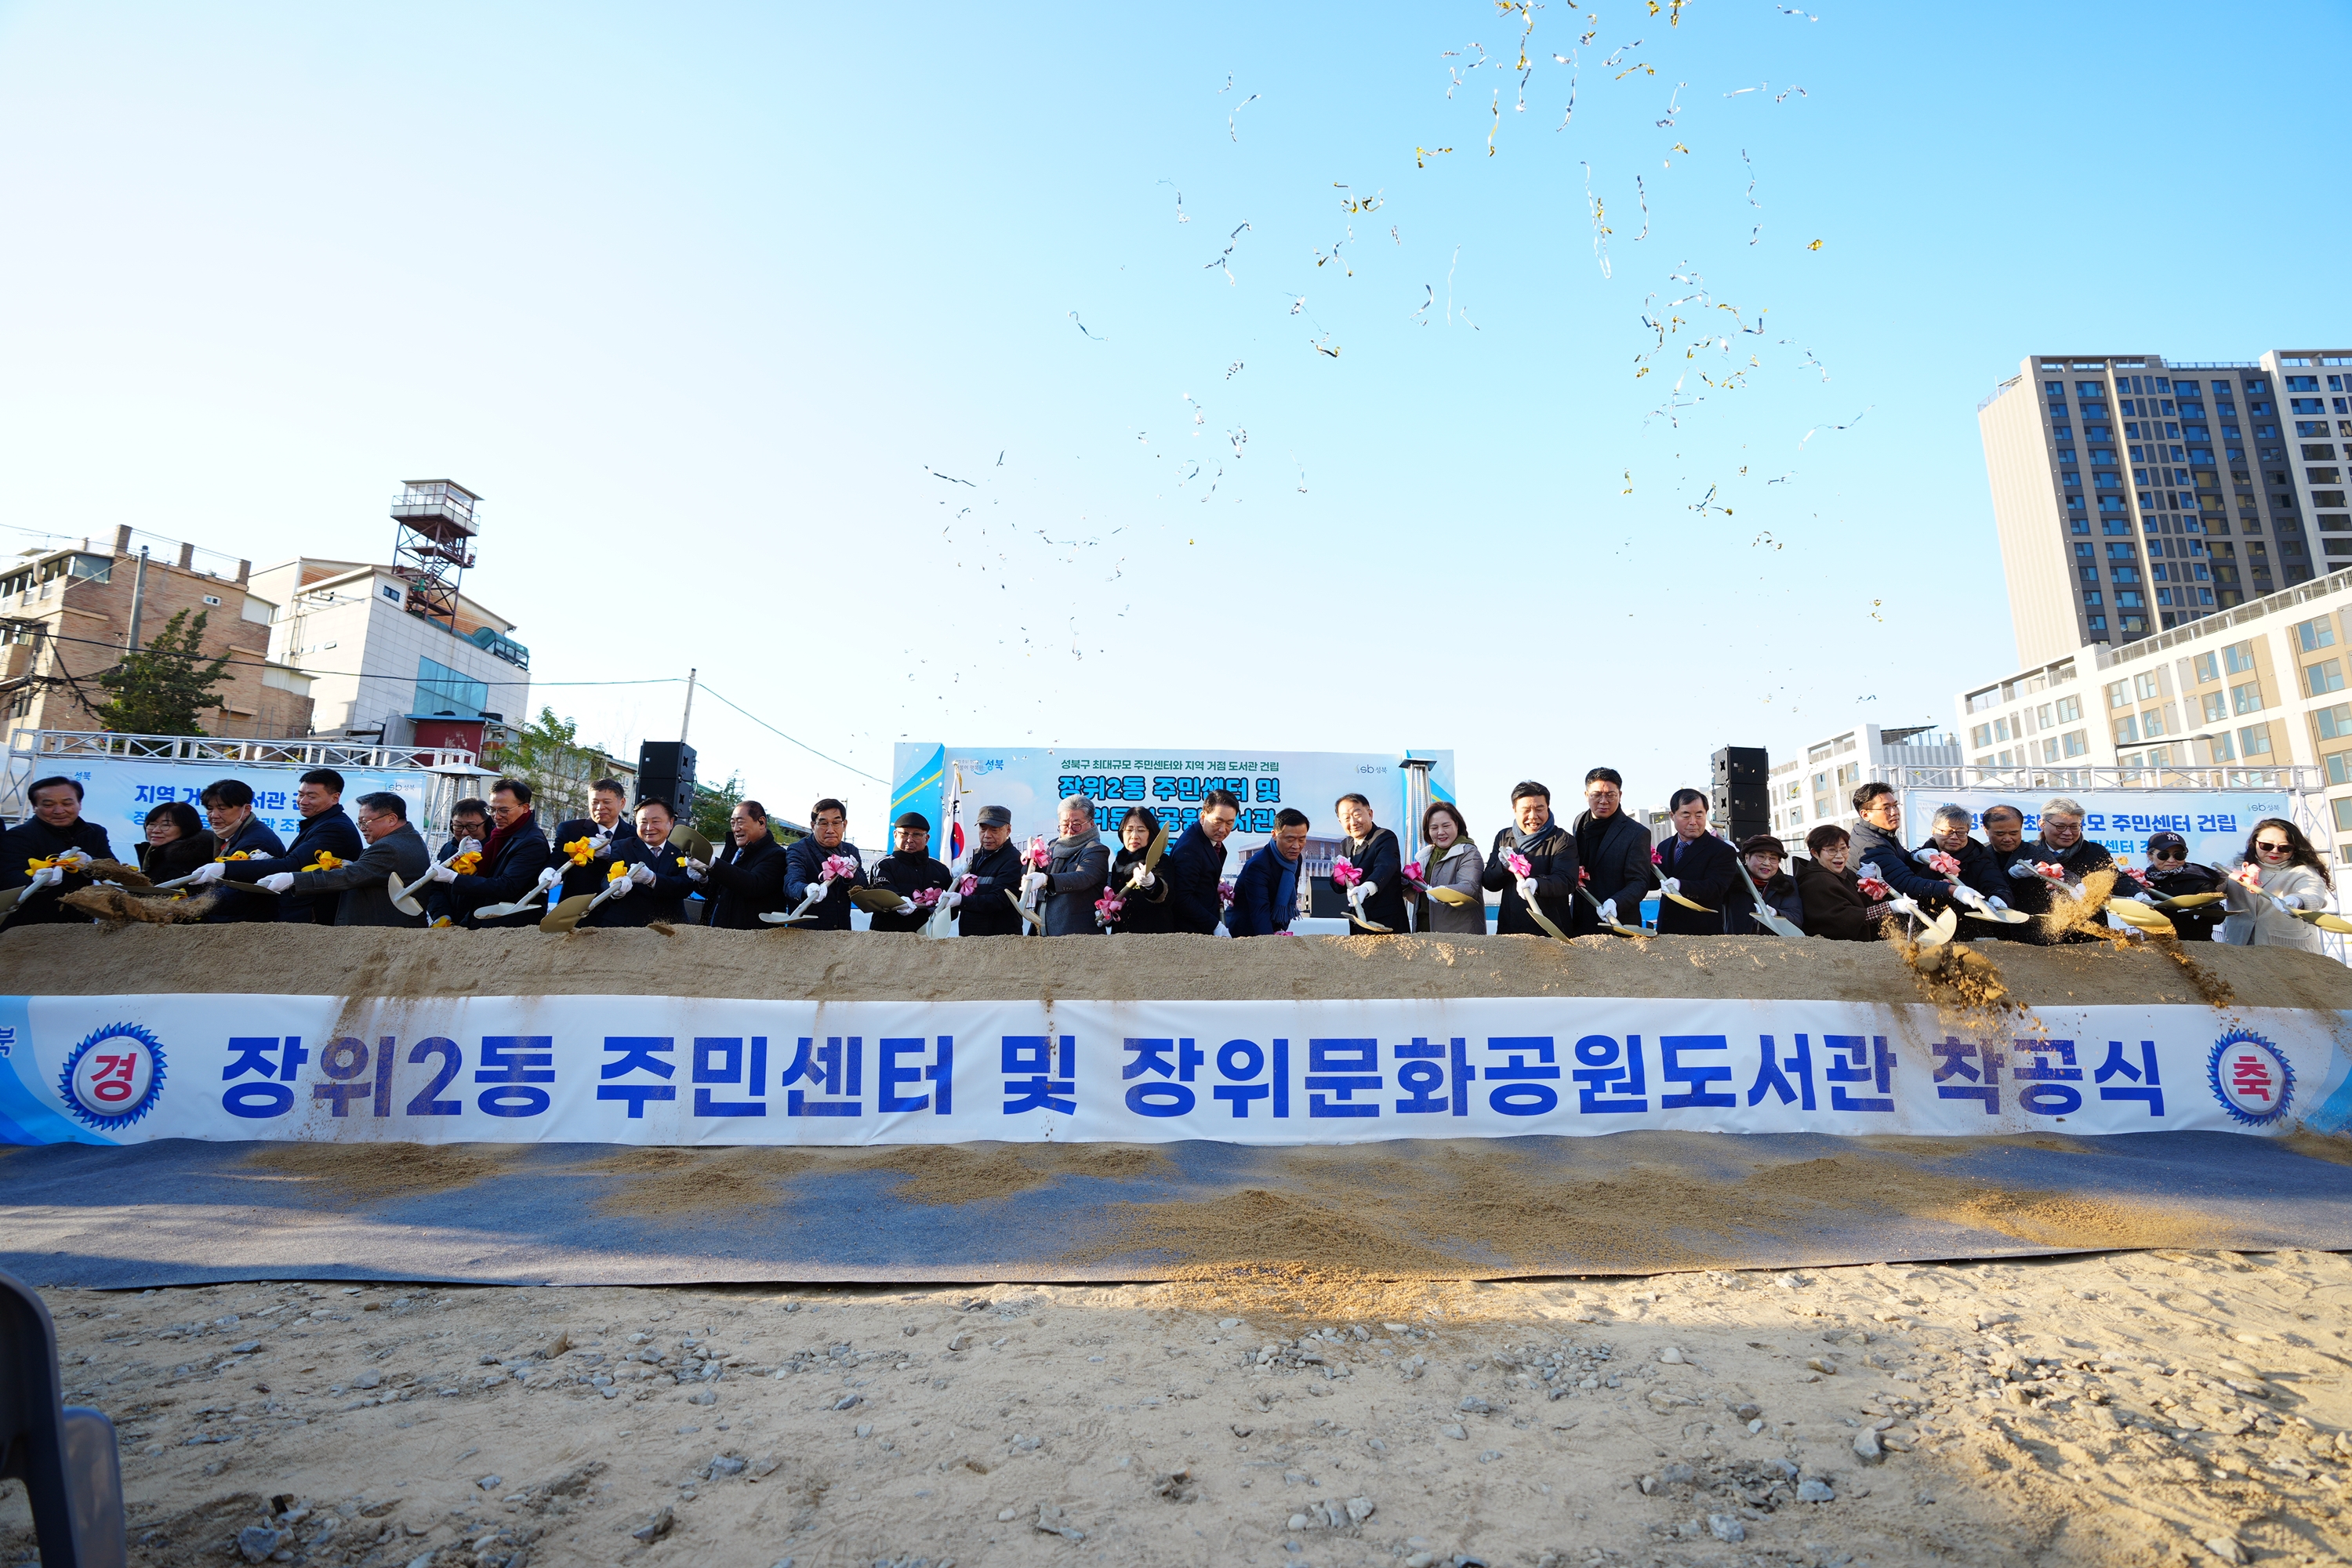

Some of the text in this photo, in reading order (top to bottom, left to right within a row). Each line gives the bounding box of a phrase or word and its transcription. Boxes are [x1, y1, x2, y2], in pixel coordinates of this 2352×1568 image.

[985, 759, 1004, 771] 성북
[1061, 760, 1279, 771] 성북구 최대규모 주민센터와 지역 거점 도서관 건립
[1360, 764, 1374, 774] sb
[74, 771, 91, 781] 성북
[388, 782, 402, 791] sb
[1058, 775, 1280, 802] 장위2동 주민센터 및
[135, 785, 175, 803] 지역
[252, 791, 286, 810] 서관
[2251, 803, 2266, 811] sb
[2112, 815, 2191, 832] 주민센터
[2197, 815, 2237, 832] 건립
[90, 1053, 137, 1102] 경
[222, 1033, 2165, 1120] 장위2동 주민센터 및 장위문화공원도서관 착공식
[2232, 1056, 2272, 1102] 축
